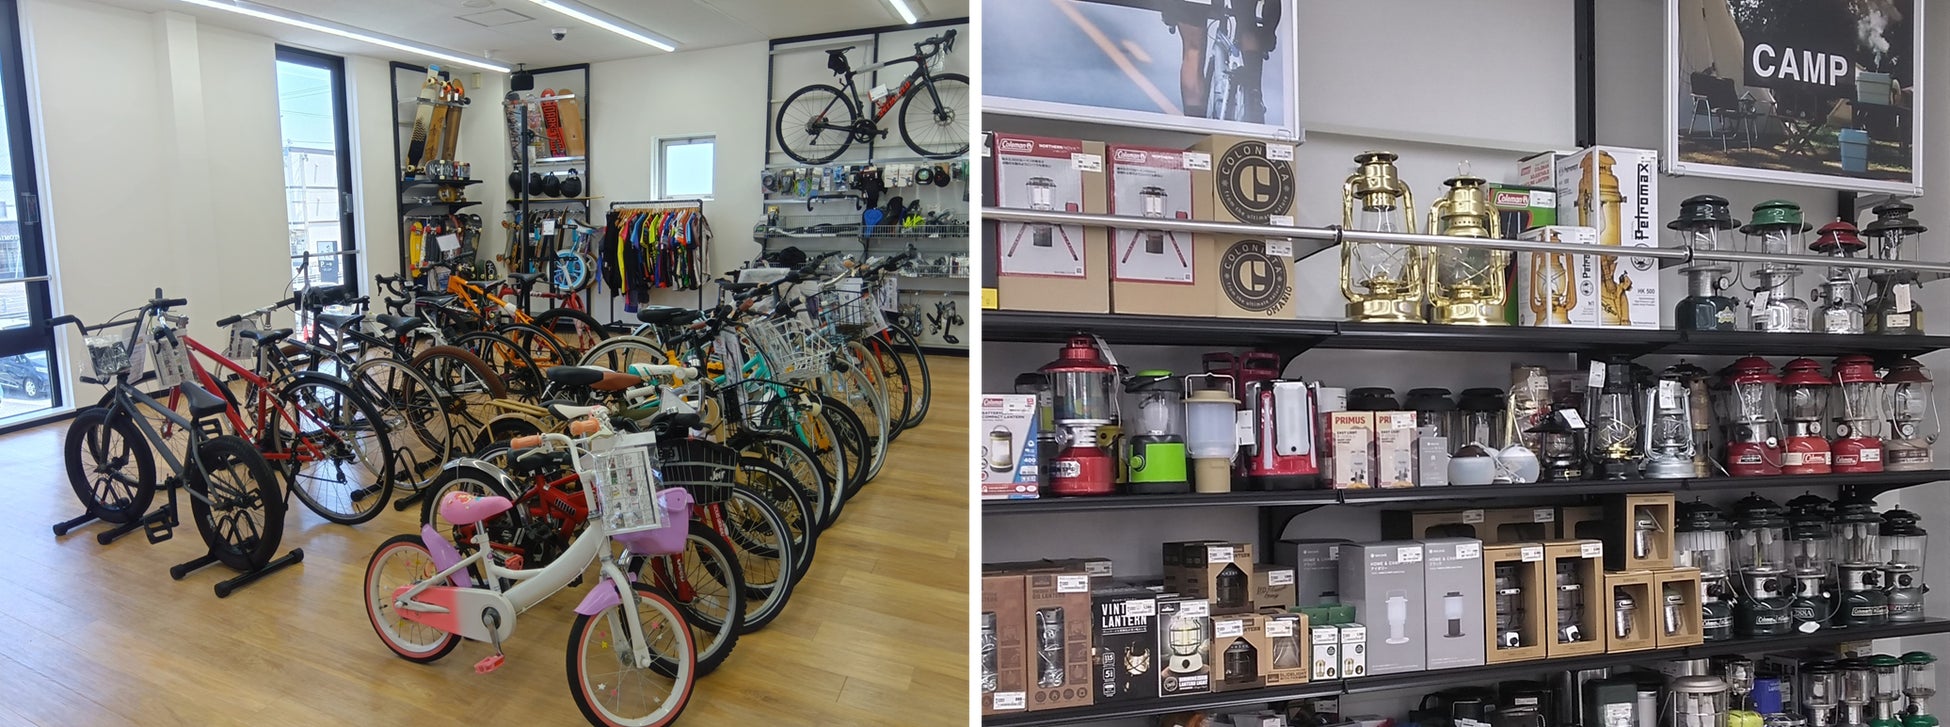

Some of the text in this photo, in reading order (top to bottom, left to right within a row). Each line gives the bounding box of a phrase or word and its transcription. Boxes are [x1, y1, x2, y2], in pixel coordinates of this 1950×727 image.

[1752, 43, 1848, 87] CAMP
[1221, 146, 1290, 182] COLONTA
[1497, 193, 1522, 203] Coleman
[1634, 163, 1649, 240] Petromax
[1247, 213, 1271, 221] ultimat
[1224, 244, 1282, 273] COLONITA
[1335, 416, 1365, 424] PRIMUS
[1379, 416, 1391, 424] PRI
[1101, 602, 1126, 616] VINT
[1102, 615, 1147, 628] LANTERN
